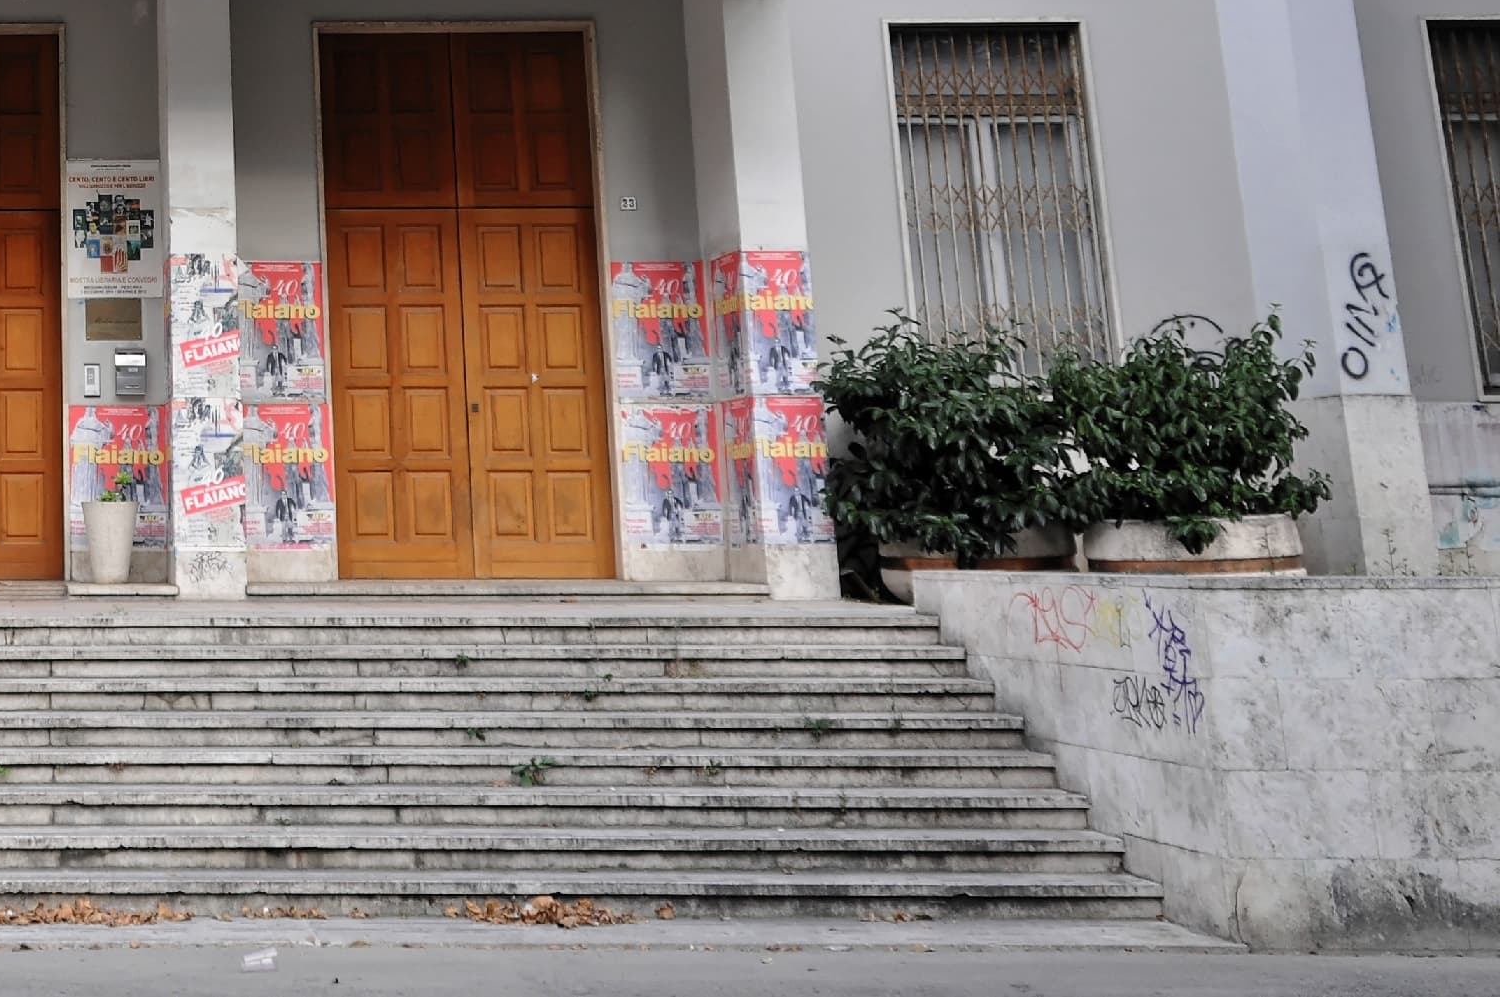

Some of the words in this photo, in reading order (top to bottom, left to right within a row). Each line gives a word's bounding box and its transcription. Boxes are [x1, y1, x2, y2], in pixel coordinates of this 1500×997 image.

[654, 278, 680, 295] 40
[770, 268, 798, 287] 40
[273, 279, 299, 296] 40
[612, 299, 703, 319] Flaiano
[184, 338, 240, 364] FLAIAN
[117, 424, 142, 441] 40
[280, 422, 306, 440] 40
[666, 422, 692, 439] 40
[791, 414, 818, 433] 40
[73, 444, 164, 465] Flaiano
[622, 442, 715, 463] Flaiano
